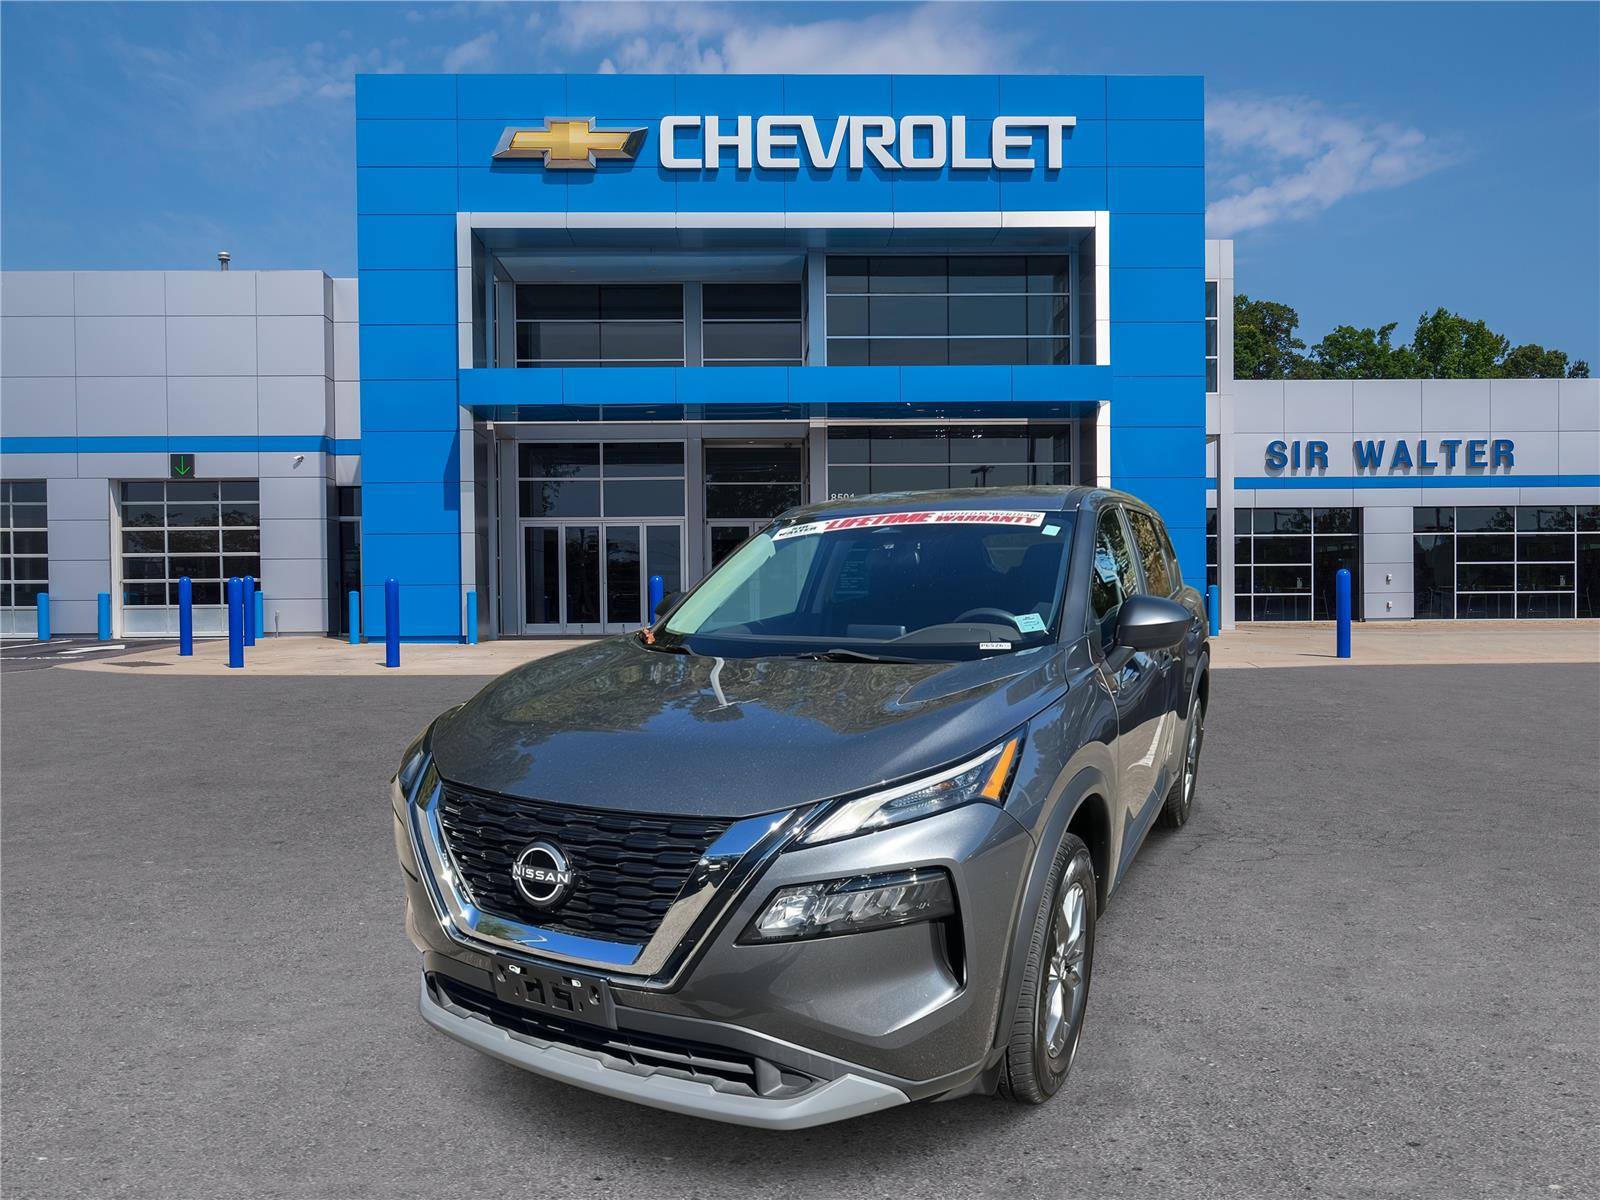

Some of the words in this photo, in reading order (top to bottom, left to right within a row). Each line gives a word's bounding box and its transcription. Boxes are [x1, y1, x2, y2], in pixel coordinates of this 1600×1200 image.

[660, 115, 1077, 169] CHEVROLET
[1265, 439, 1329, 470] SIR
[1352, 439, 1515, 468] WALTER
[824, 512, 936, 530] LIFETIME
[936, 515, 1037, 524] WARRANTY
[512, 862, 569, 883] NISSAN
